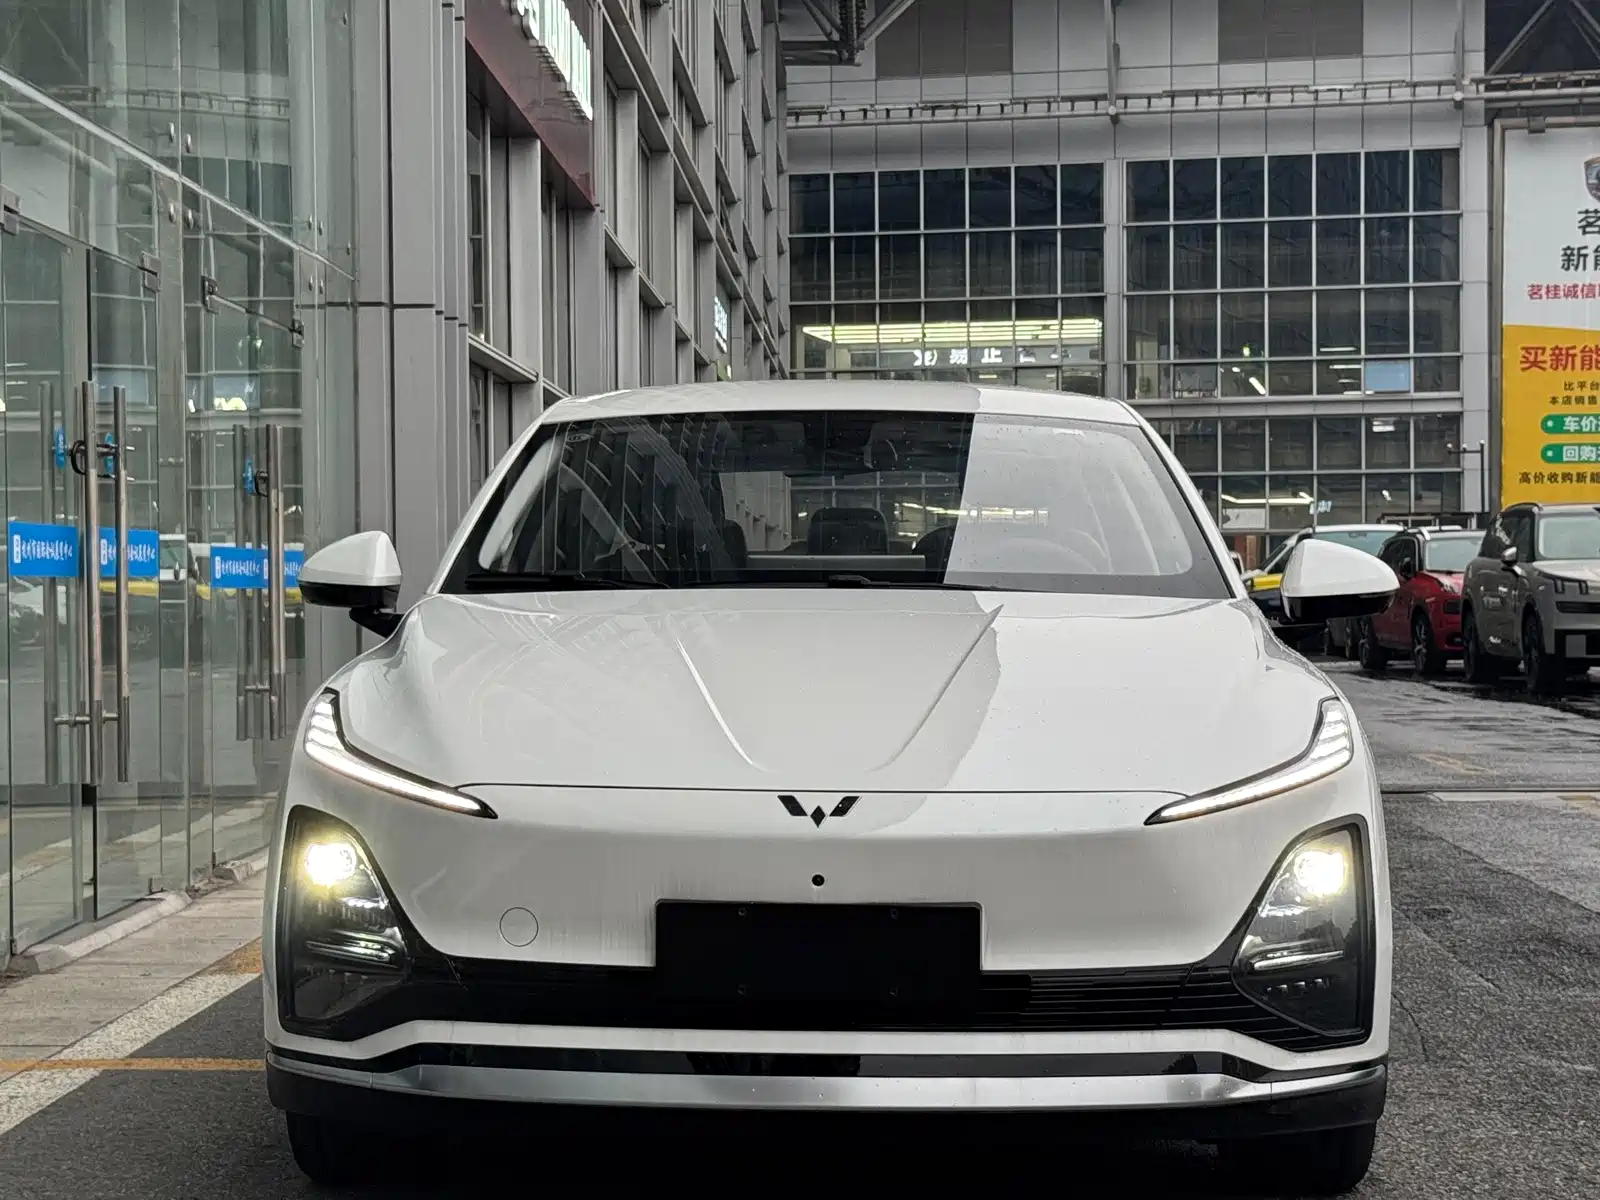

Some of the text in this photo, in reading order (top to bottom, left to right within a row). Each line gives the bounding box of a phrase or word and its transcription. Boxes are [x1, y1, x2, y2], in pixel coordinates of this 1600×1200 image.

[1561, 245, 1600, 272] 新
[1527, 283, 1600, 300] 茗桂诚信
[1563, 415, 1600, 432] 车价
[1562, 445, 1600, 462] 回购
